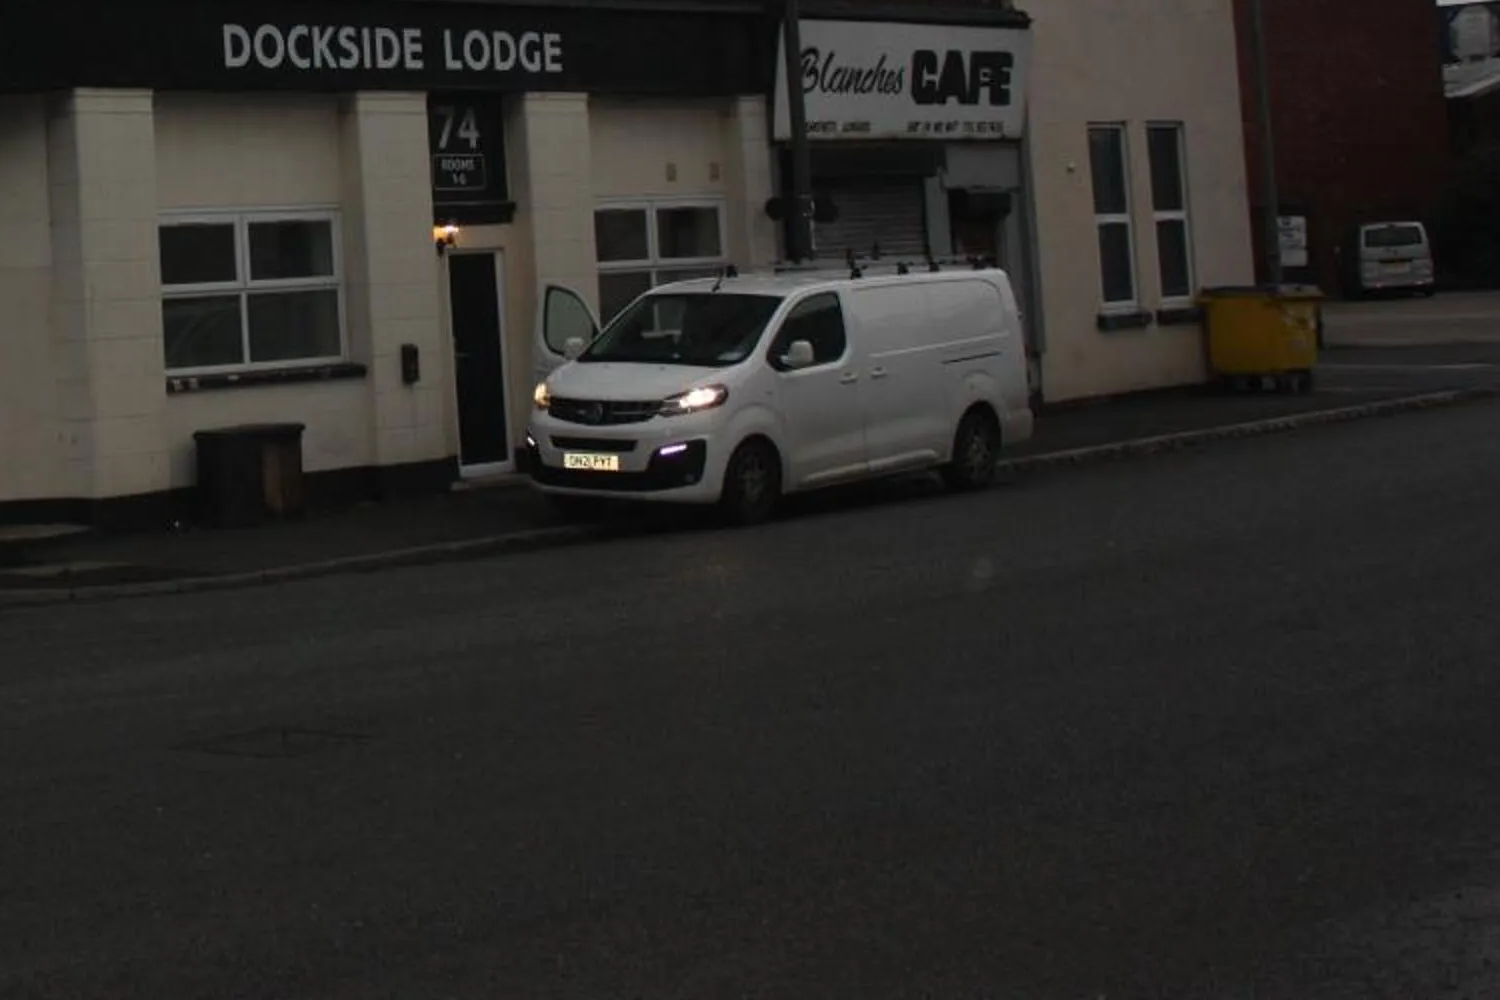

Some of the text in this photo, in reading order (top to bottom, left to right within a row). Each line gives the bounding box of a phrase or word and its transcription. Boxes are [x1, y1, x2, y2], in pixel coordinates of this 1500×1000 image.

[223, 23, 563, 72] DOCKSIDE LODGE
[911, 49, 1013, 106] CAFE
[435, 106, 480, 149] 74
